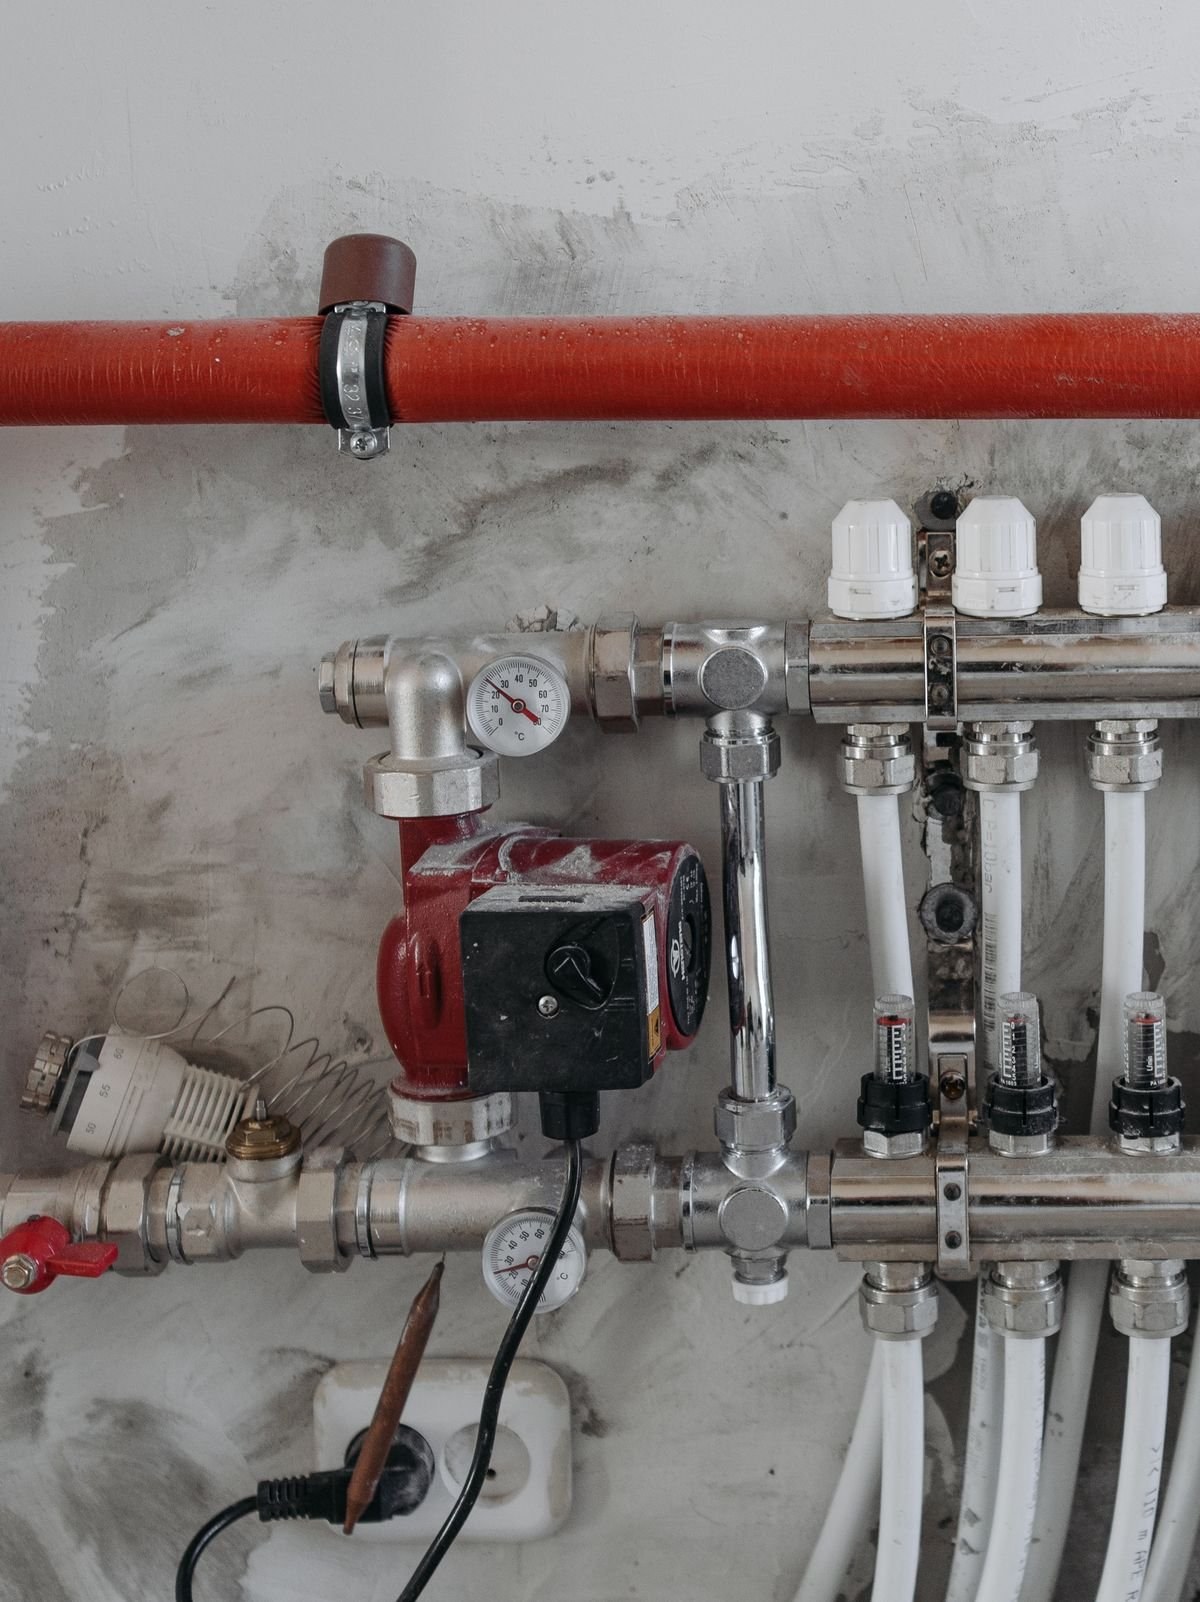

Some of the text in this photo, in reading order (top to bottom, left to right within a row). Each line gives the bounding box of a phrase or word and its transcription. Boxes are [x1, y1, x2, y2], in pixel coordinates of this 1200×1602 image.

[515, 674, 523, 683] 40
[529, 679, 537, 687] 50
[501, 680, 509, 689] 30
[491, 690, 500, 699] 20
[539, 690, 547, 698] 60
[491, 705, 498, 713] 10
[541, 704, 549, 712] 70
[498, 717, 503, 726] 0
[99, 1083, 111, 1098] 55
[85, 1121, 97, 1134] 50
[519, 1231, 530, 1241] 50
[534, 1228, 545, 1239] 60
[508, 1240, 518, 1250] 40
[504, 1255, 514, 1265] 30
[509, 1269, 519, 1279] 20
